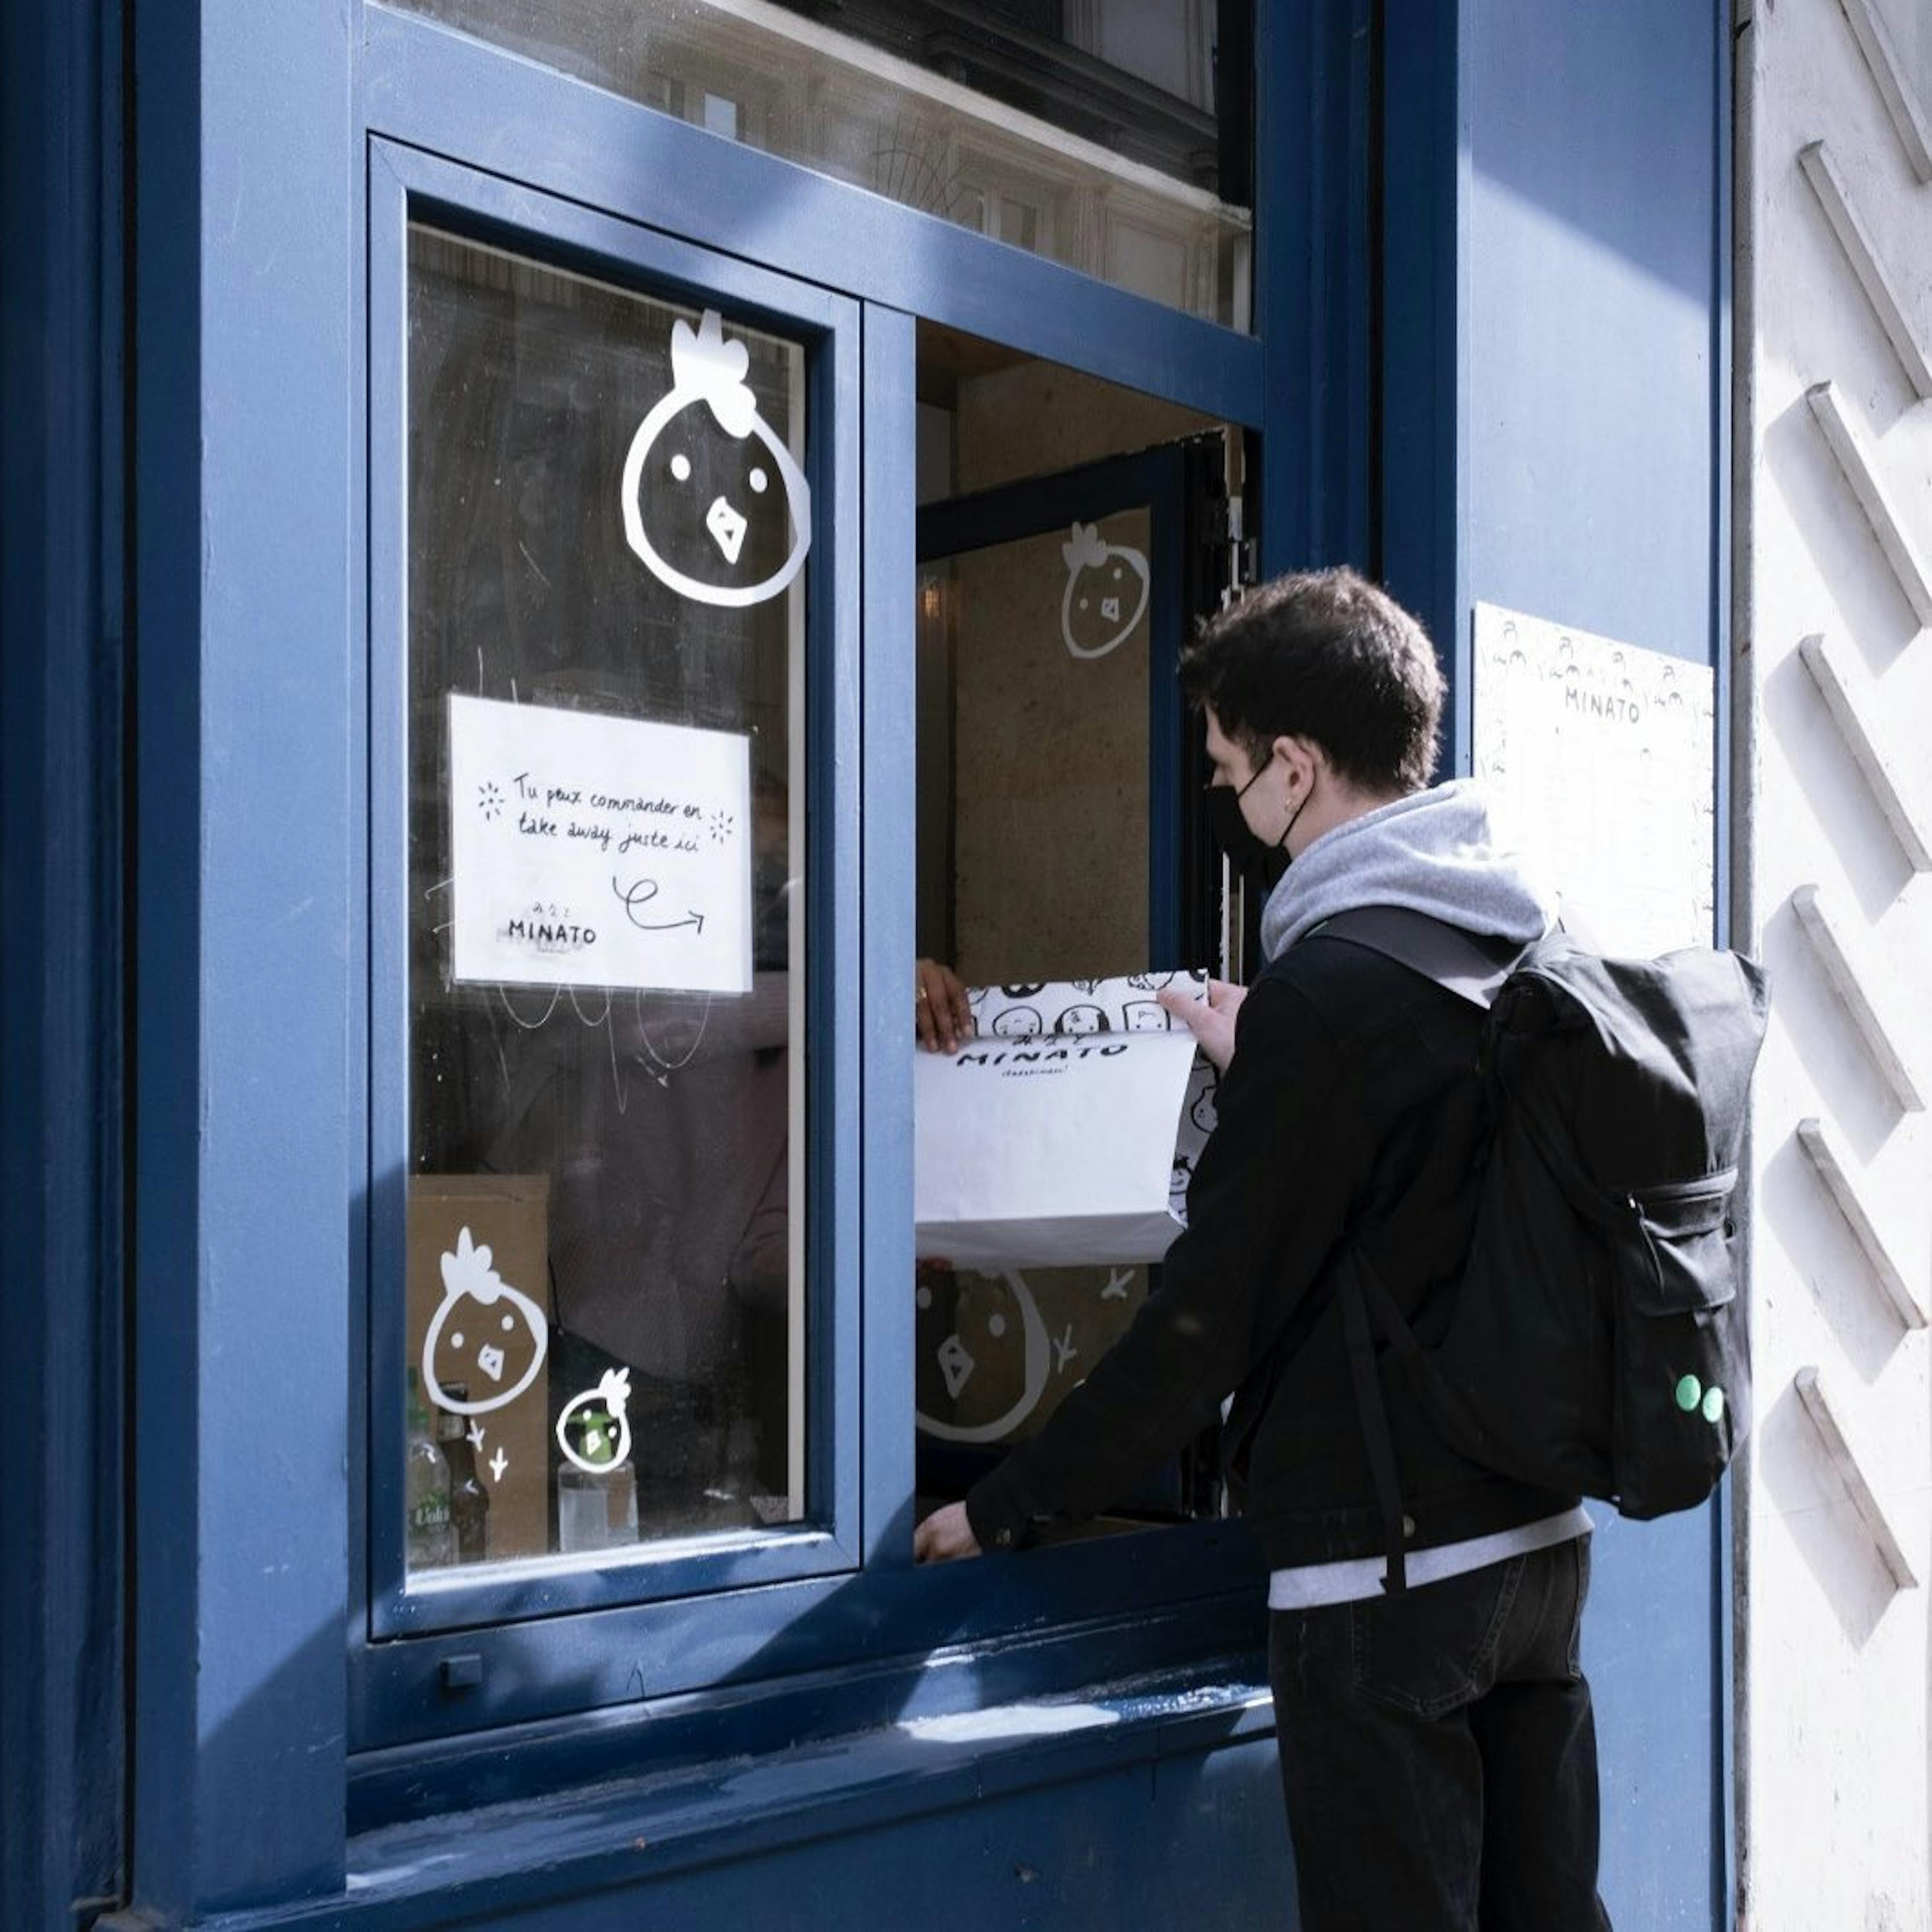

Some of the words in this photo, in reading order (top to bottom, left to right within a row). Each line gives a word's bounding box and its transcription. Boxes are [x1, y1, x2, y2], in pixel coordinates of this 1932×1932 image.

[1565, 684, 1639, 723] MINATO
[513, 772, 538, 798] Tu
[547, 788, 582, 808] peux
[590, 793, 680, 815] commander
[683, 805, 702, 820] en
[519, 812, 557, 836] take
[567, 822, 612, 851] away
[618, 823, 668, 853] juste
[674, 834, 699, 852] ici
[509, 919, 596, 943] MINATO
[956, 1044, 1128, 1067] MINATO
